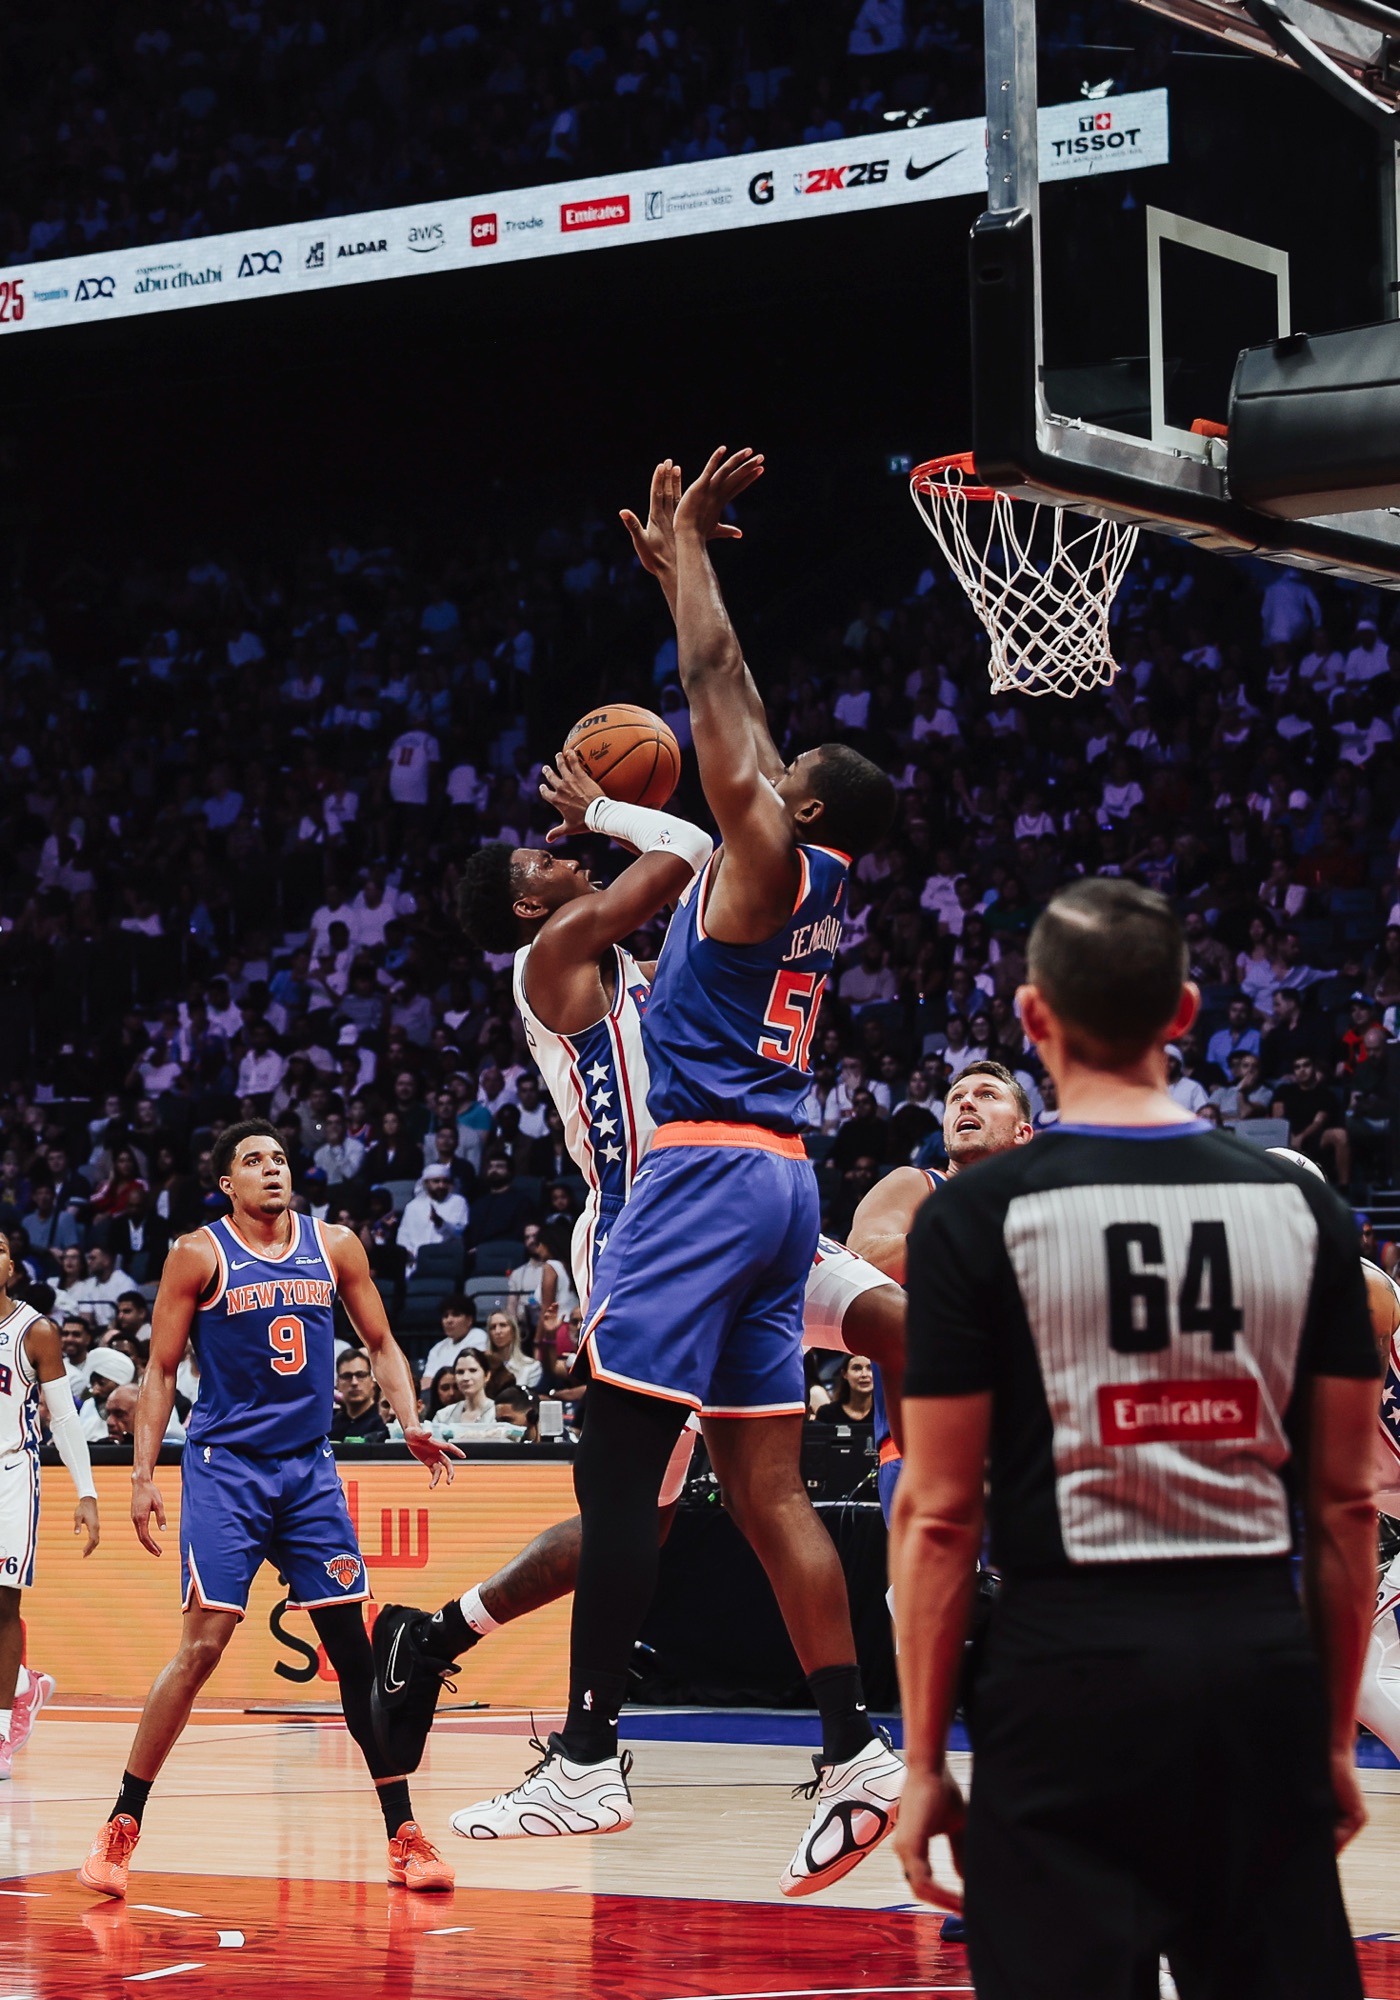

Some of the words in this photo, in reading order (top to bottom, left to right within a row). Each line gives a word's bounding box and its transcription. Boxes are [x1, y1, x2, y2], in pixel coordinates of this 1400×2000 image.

[1052, 128, 1141, 158] TISSOT
[748, 171, 774, 206] G
[805, 160, 890, 194] 2K26
[566, 204, 625, 225] Emirates
[408, 223, 444, 243] aws
[472, 222, 496, 239] CFI
[238, 250, 283, 279] ADQ
[337, 239, 388, 259] ALDAR
[75, 276, 116, 302] ADQ
[134, 276, 168, 295] abu
[171, 264, 223, 289] dhabi
[0, 279, 24, 322] 25
[226, 1281, 277, 1316] NEW
[277, 1278, 333, 1308] YORK
[1104, 1219, 1245, 1355] 64
[268, 1314, 307, 1376] 9
[1114, 1395, 1243, 1431] Emirates
